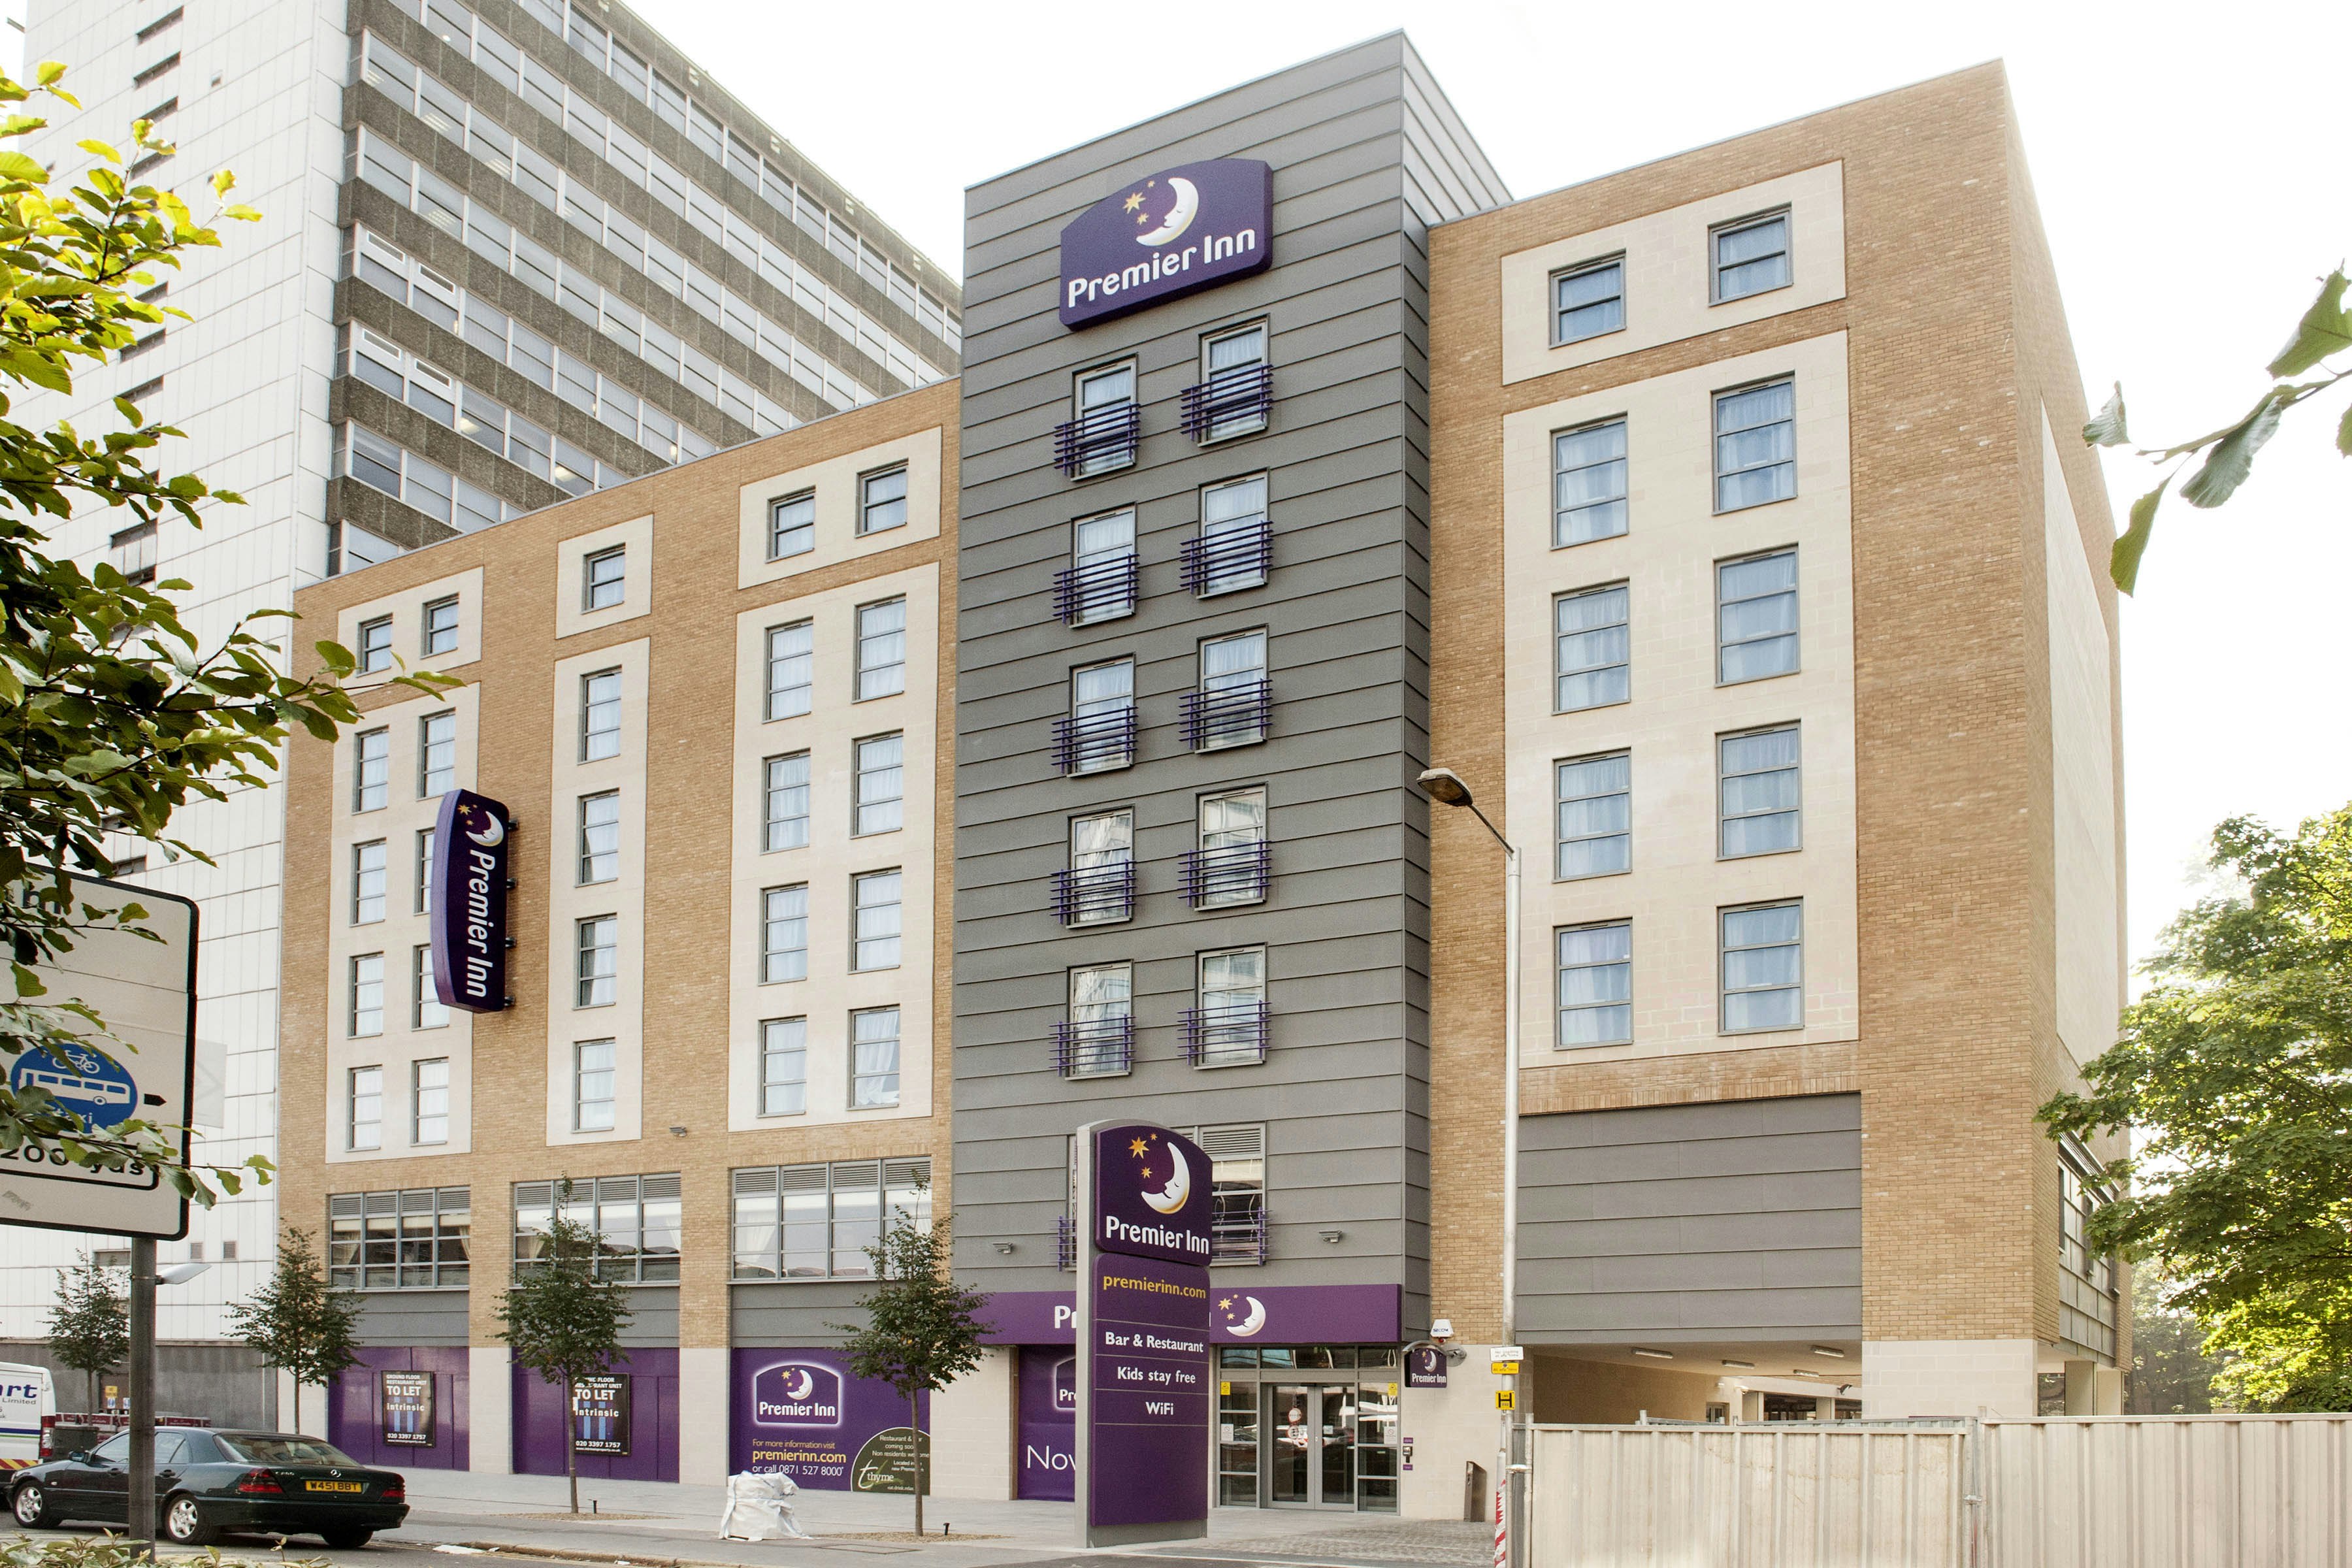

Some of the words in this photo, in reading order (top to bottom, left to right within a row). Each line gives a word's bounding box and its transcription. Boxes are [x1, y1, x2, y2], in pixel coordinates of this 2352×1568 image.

[1068, 246, 1197, 308] Premier
[1204, 229, 1255, 264] Inn
[466, 849, 496, 954] Premier
[466, 956, 493, 998] Inn
[55, 1108, 92, 1124] txi
[1106, 1215, 1184, 1249] Premier
[1186, 1230, 1209, 1255] Inn
[1103, 1276, 1207, 1299] premierinn.com
[1105, 1331, 1130, 1346] Bar
[1133, 1334, 1143, 1347] &
[1147, 1335, 1203, 1353] Restaurant
[1117, 1366, 1144, 1380] Kids
[1148, 1371, 1171, 1385] stay
[1175, 1370, 1196, 1384] free
[1412, 1373, 1436, 1383] Premier
[1437, 1373, 1446, 1383] Inn
[0, 1384, 37, 1398] rt
[387, 1386, 401, 1396] TO
[403, 1386, 421, 1396] LET
[575, 1389, 591, 1399] TO
[595, 1390, 615, 1400] LET
[387, 1403, 425, 1411] intrinsic
[1498, 1392, 1512, 1408] H
[759, 1401, 813, 1416] Premier
[815, 1403, 836, 1416] Inn
[1145, 1401, 1174, 1415] WiFi
[784, 1440, 823, 1448] information
[752, 1449, 847, 1463] premierinn.com
[764, 1465, 777, 1473] call
[778, 1465, 799, 1474] 0871
[802, 1466, 819, 1475] 527
[867, 1472, 894, 1482] thyme
[310, 1481, 335, 1490] W451
